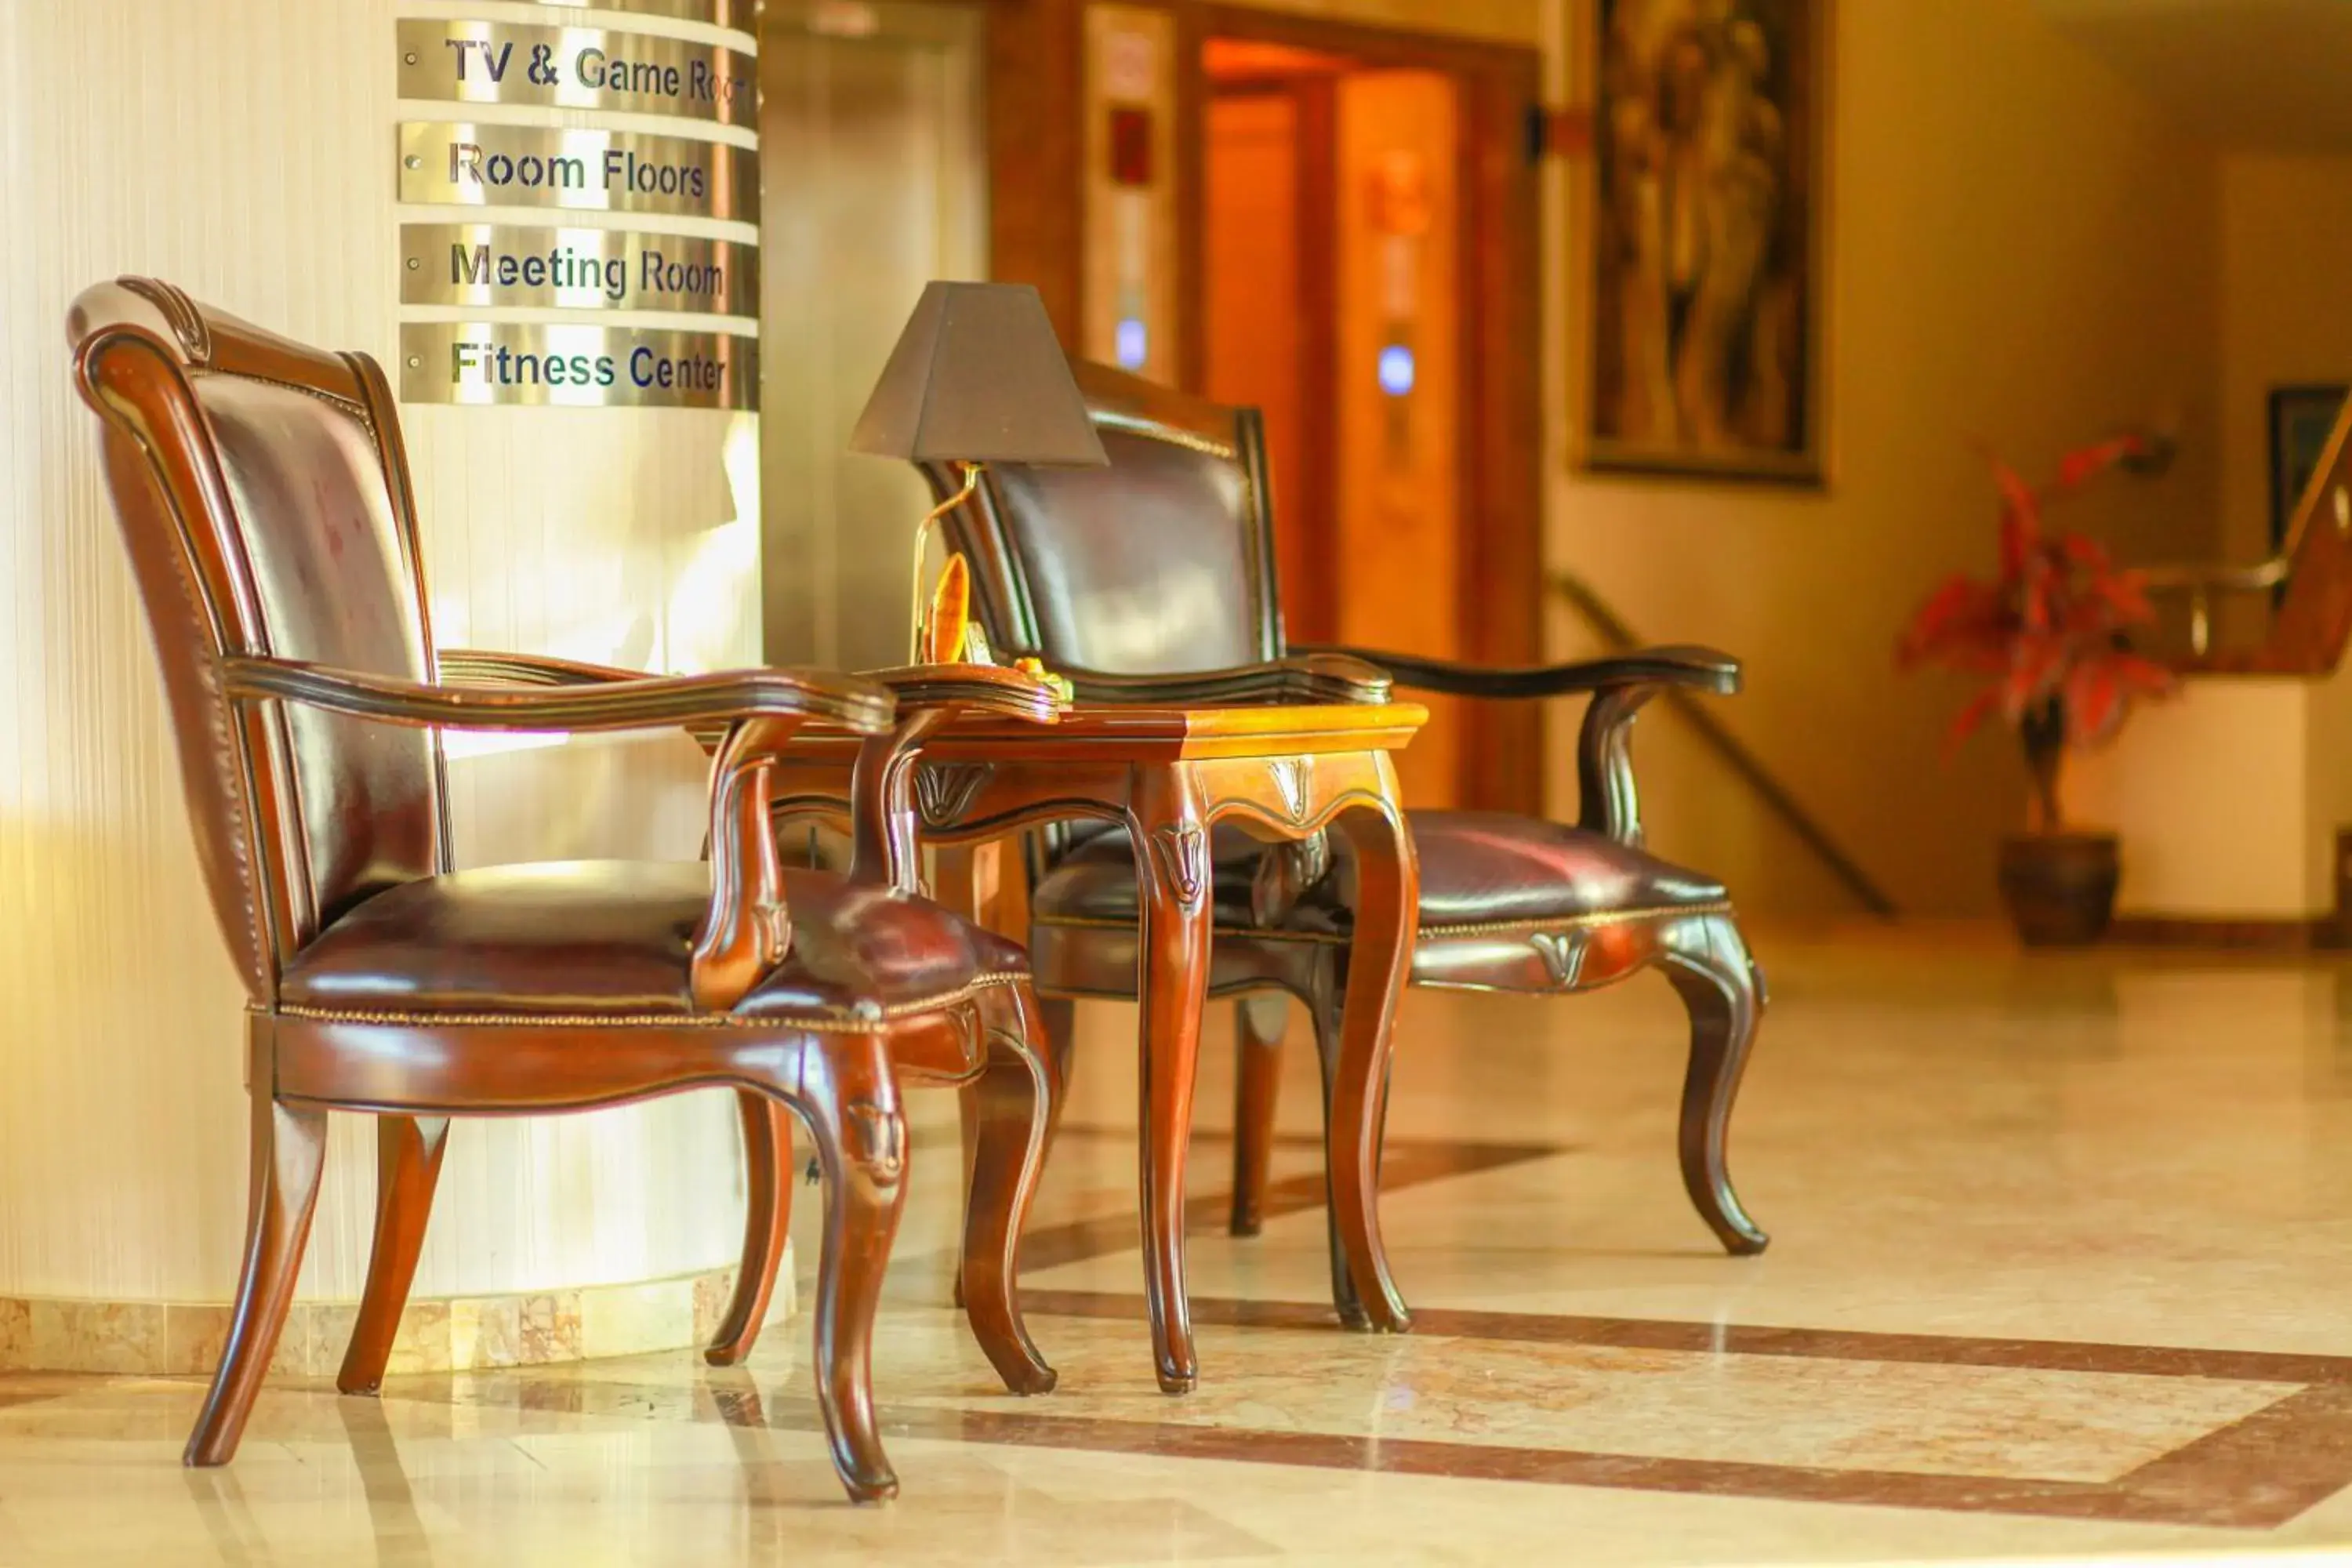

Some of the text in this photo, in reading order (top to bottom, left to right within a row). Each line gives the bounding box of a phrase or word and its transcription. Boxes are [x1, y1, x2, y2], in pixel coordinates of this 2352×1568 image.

[445, 38, 513, 82] TV
[528, 44, 559, 85] &
[576, 48, 679, 96] Game
[449, 143, 704, 198] Room Floors
[452, 244, 724, 299] Meeting Room
[452, 343, 726, 390] Fitness Center
